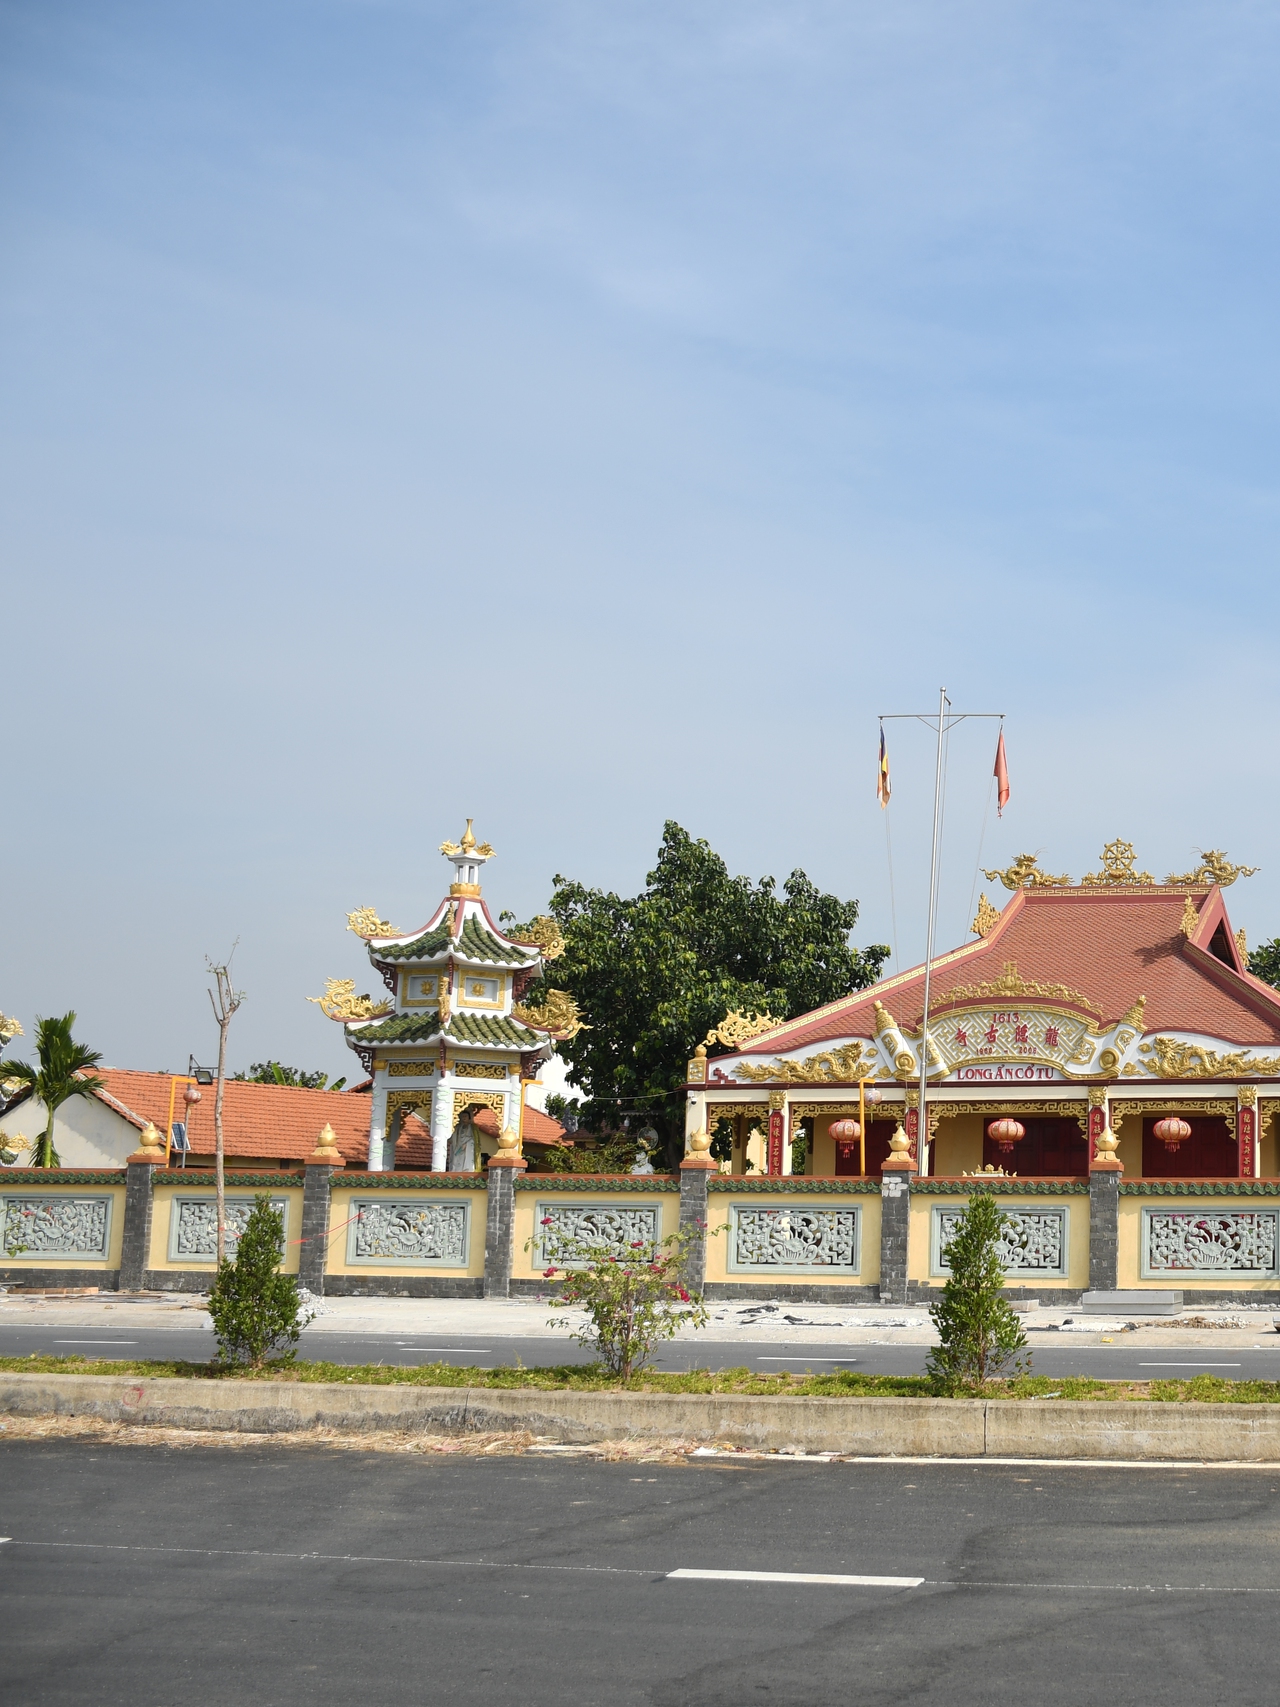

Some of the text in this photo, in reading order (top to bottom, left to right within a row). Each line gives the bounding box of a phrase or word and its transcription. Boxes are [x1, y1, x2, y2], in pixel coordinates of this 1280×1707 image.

[993, 1013, 1020, 1023] 1613
[957, 1068, 993, 1080] LONG
[994, 1064, 1013, 1080] ẨN
[1015, 1063, 1035, 1080] CỔ
